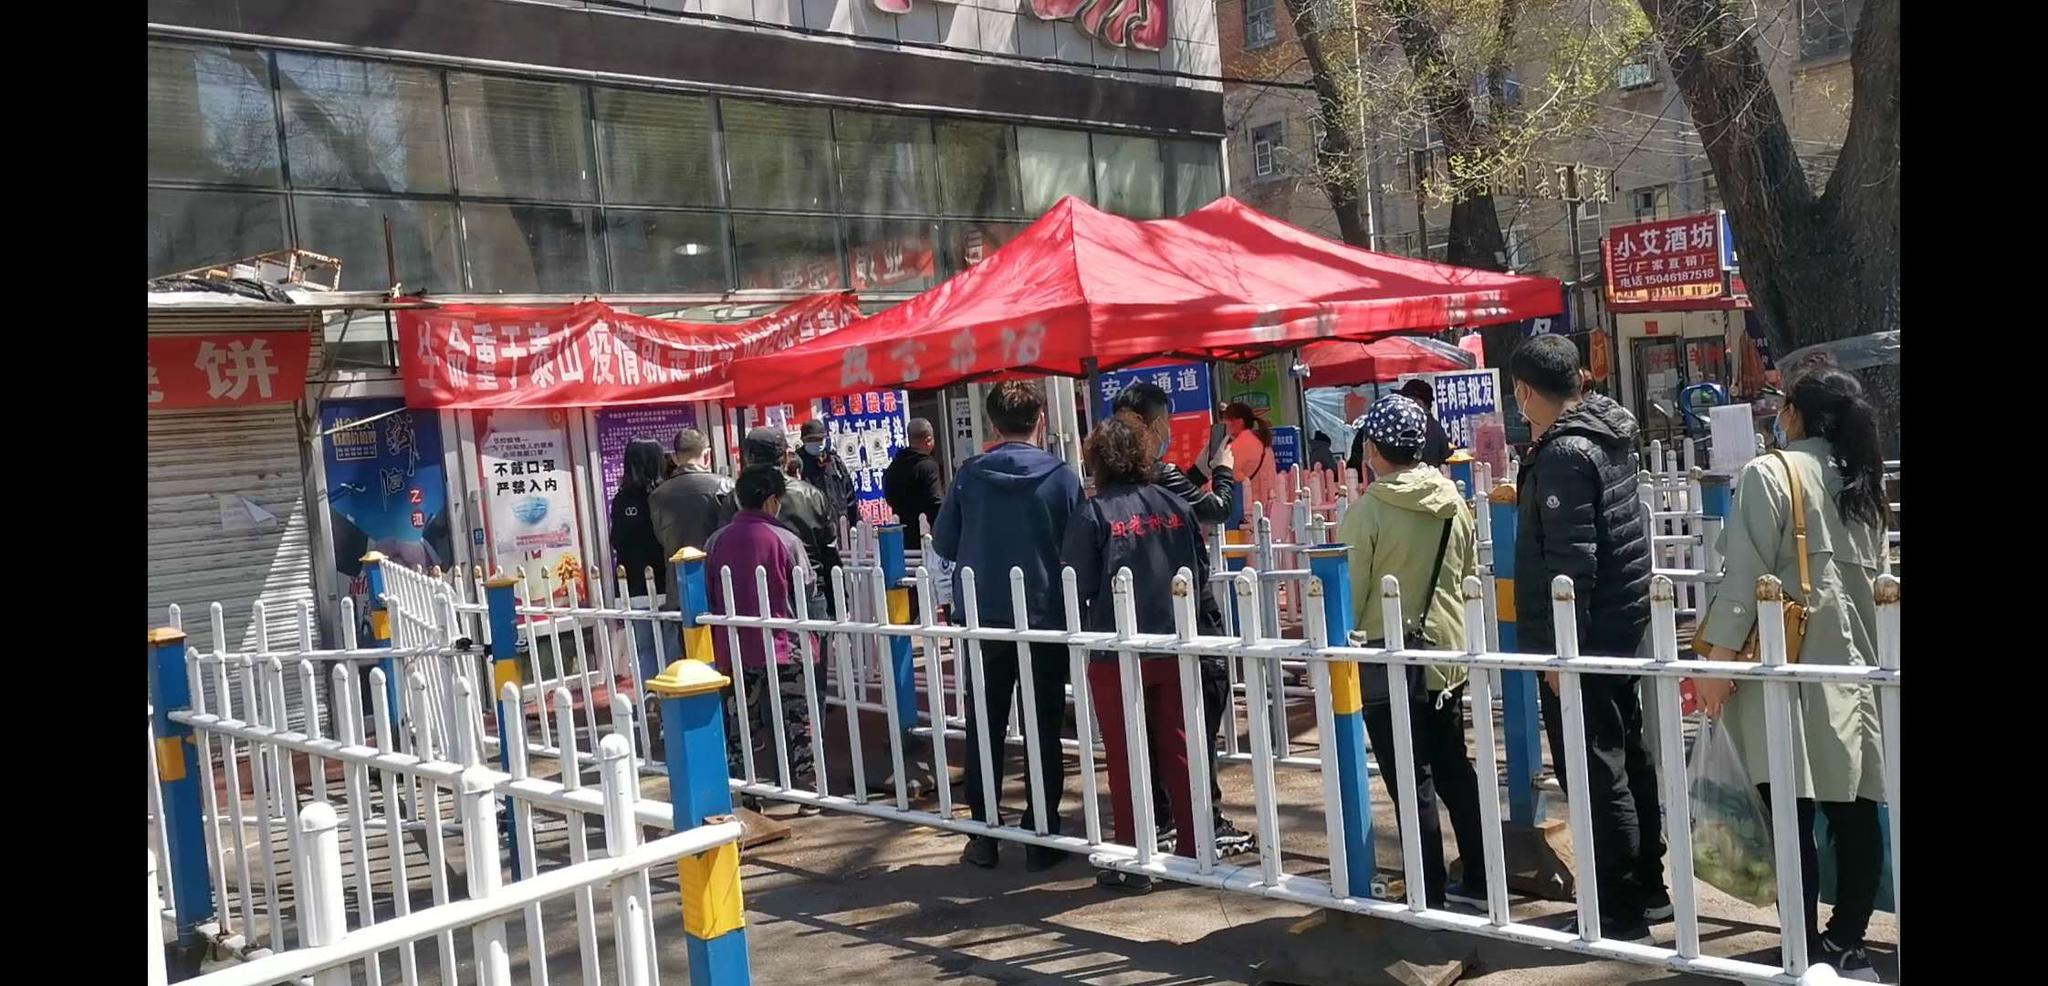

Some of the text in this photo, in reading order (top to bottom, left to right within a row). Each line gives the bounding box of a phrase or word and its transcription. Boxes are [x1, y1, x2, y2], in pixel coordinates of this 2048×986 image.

[1614, 221, 1714, 258] 小艾酒坊
[1621, 268, 1714, 288] 电话 15046187518
[1437, 375, 1494, 411] 羊肉串批发
[494, 459, 556, 477] 不戴口罩
[496, 478, 558, 496] 严禁入内
